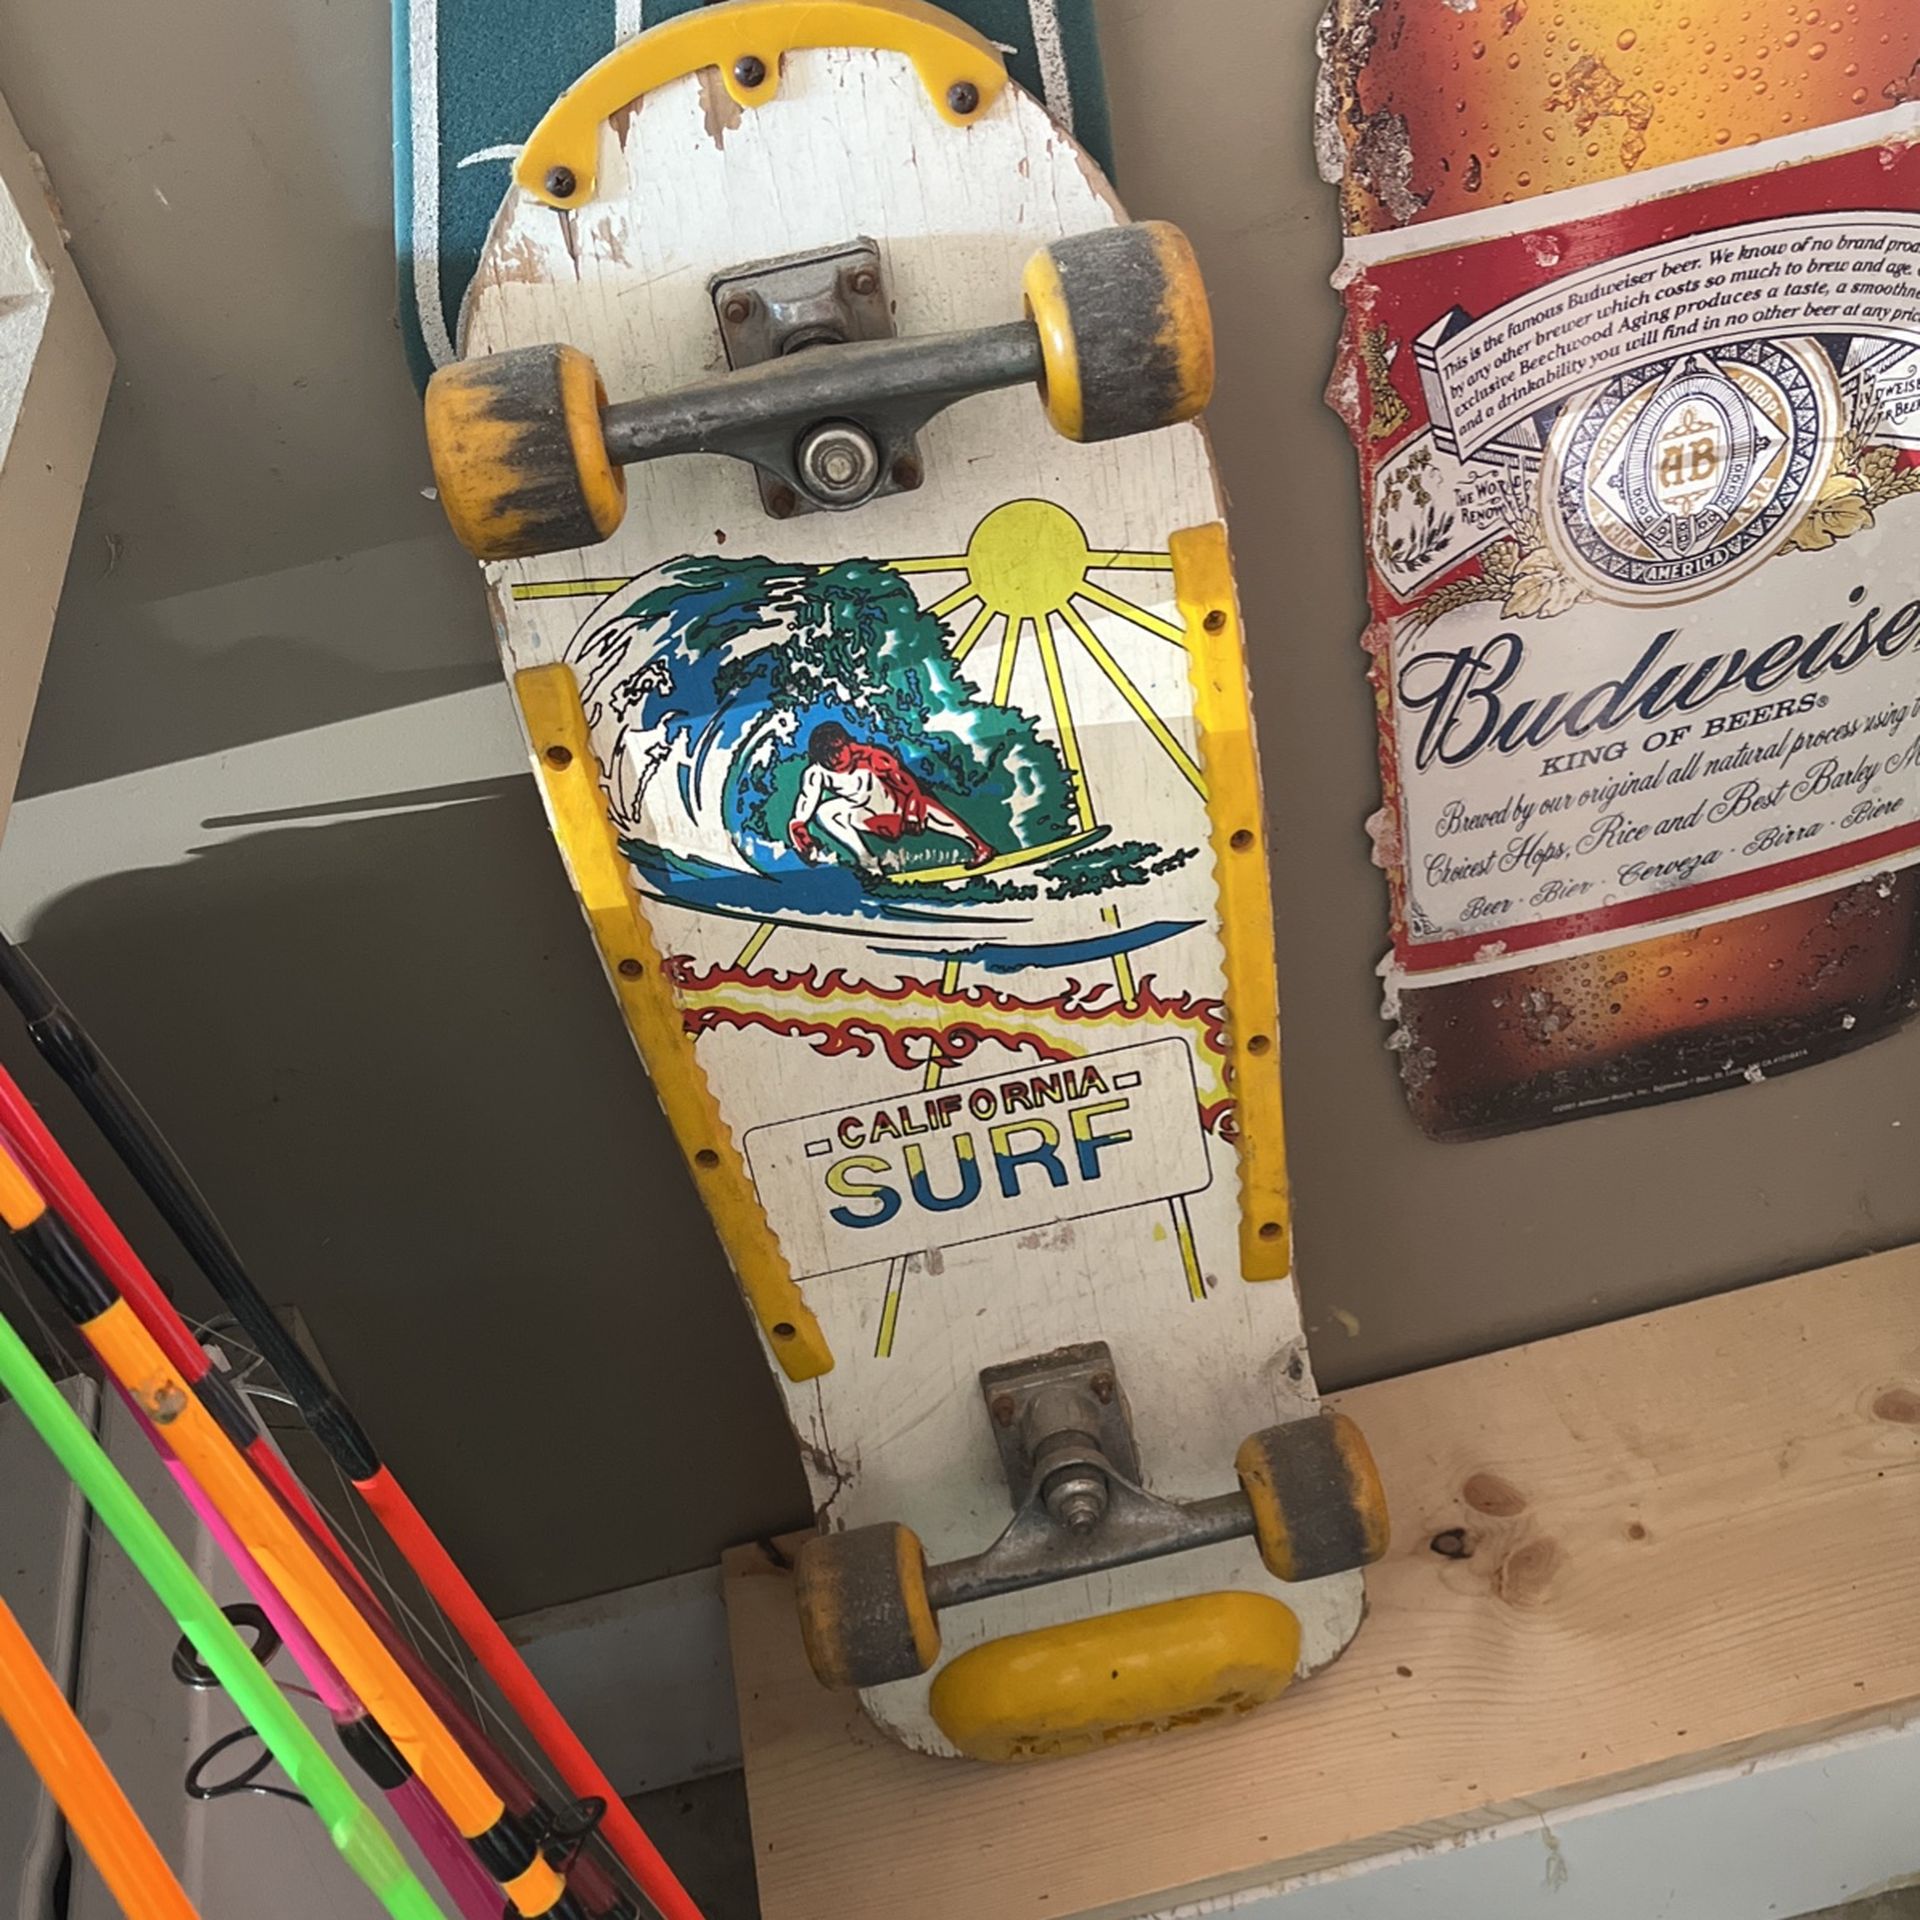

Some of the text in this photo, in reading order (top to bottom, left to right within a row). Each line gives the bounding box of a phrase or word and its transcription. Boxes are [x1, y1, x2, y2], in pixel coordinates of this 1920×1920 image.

[1442, 358, 1468, 380] This
[1470, 347, 1481, 364] is
[1483, 334, 1504, 352] the
[1507, 304, 1564, 338] famous
[1568, 269, 1657, 310] Budweiser
[1661, 258, 1701, 278] beer.
[1709, 248, 1734, 265] We
[1737, 243, 1787, 261] know
[1790, 236, 1813, 253] of
[1811, 239, 1833, 250] no
[1836, 234, 1888, 250] brand
[1450, 382, 1464, 400] by
[1467, 362, 1491, 387] any
[1494, 339, 1532, 368] other
[1535, 311, 1593, 346] brewer
[1597, 290, 1650, 320] which
[1654, 278, 1700, 300] costs
[1704, 274, 1725, 288] so
[1729, 262, 1781, 284] much
[1785, 261, 1802, 276] to
[1806, 258, 1850, 273] brew
[1852, 257, 1886, 273] and
[1454, 370, 1516, 418] exclusive
[1520, 322, 1613, 376] Beechwood
[1617, 306, 1671, 334] Aging
[1673, 288, 1762, 320] produces
[1767, 287, 1779, 299] a
[1783, 281, 1830, 297] taste,
[1835, 282, 1848, 294] a
[1458, 415, 1484, 437] and
[1485, 406, 1495, 418] a
[1498, 356, 1587, 413] drinkability
[1588, 343, 1621, 369] you
[1625, 329, 1659, 352] will
[1662, 318, 1699, 341] find
[1703, 316, 1721, 331] in
[1724, 312, 1749, 328] no
[1752, 304, 1801, 322] other
[1803, 302, 1841, 317] beer
[1842, 303, 1859, 317] at
[1862, 306, 1891, 321] any
[1738, 374, 1782, 419] EUROPE
[1659, 437, 1717, 488] AB
[1734, 477, 1776, 523] ASIA
[1646, 553, 1724, 580] AMERICA
[1400, 585, 1920, 772] Budweise
[1435, 796, 1514, 838] Brewed
[1513, 793, 1536, 832] by
[1539, 793, 1575, 816] our
[1577, 759, 1669, 814] original
[1666, 751, 1705, 785] all
[1703, 728, 1793, 777] natural
[1780, 719, 1861, 770] process
[1863, 702, 1910, 737] using
[1539, 741, 1628, 777] KING
[1642, 725, 1692, 752] OF
[1424, 850, 1498, 888] Choicest
[1498, 830, 1570, 877] Hops,
[1575, 812, 1651, 855] Rice
[1653, 798, 1708, 836] and
[1707, 777, 1790, 823] Best
[1789, 755, 1881, 801] Barley
[1459, 895, 1514, 922] Beer
[1529, 878, 1595, 907] Bier
[1617, 849, 1724, 887] Cerveza
[1742, 822, 1824, 856] Birra
[825, 1098, 1133, 1229] SURF
[838, 1065, 1106, 1149] CALIFORNIA
